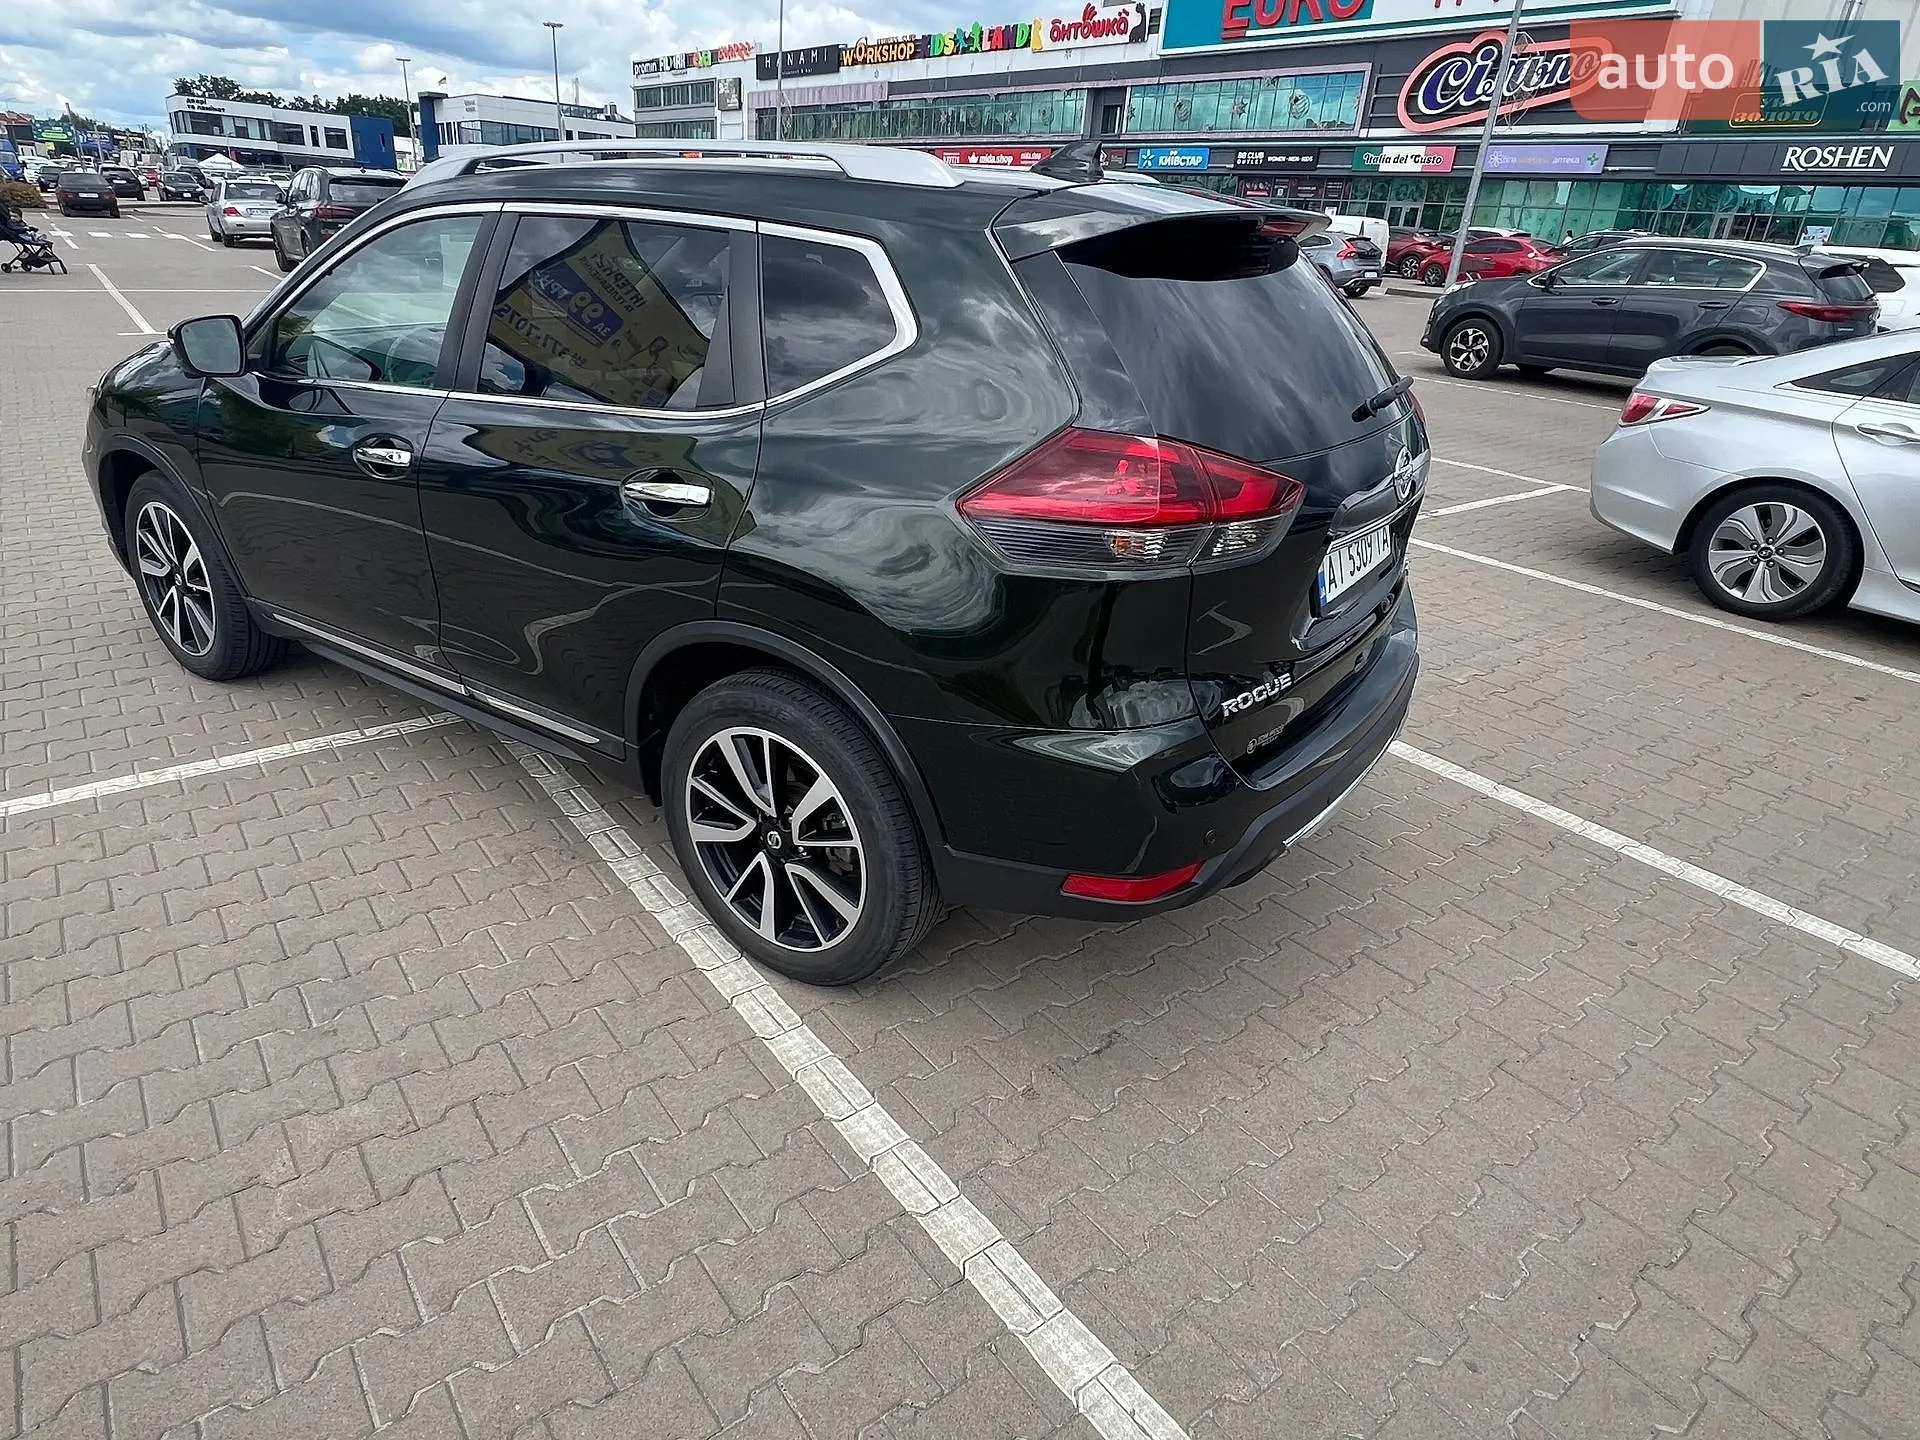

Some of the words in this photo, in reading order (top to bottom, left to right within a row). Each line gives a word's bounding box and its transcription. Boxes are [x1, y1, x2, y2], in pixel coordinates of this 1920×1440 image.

[765, 48, 828, 68] HANAMI
[842, 41, 915, 66] WORKSHOP
[1158, 150, 1203, 167] КИЇВСТАР
[1248, 151, 1264, 159] CLUB
[1363, 152, 1392, 165] Italia
[1393, 153, 1408, 164] del
[1781, 145, 1895, 172] ROSHEN
[1328, 550, 1344, 593] AI
[1348, 535, 1373, 577] 5309
[1221, 673, 1292, 717] ROGUE
